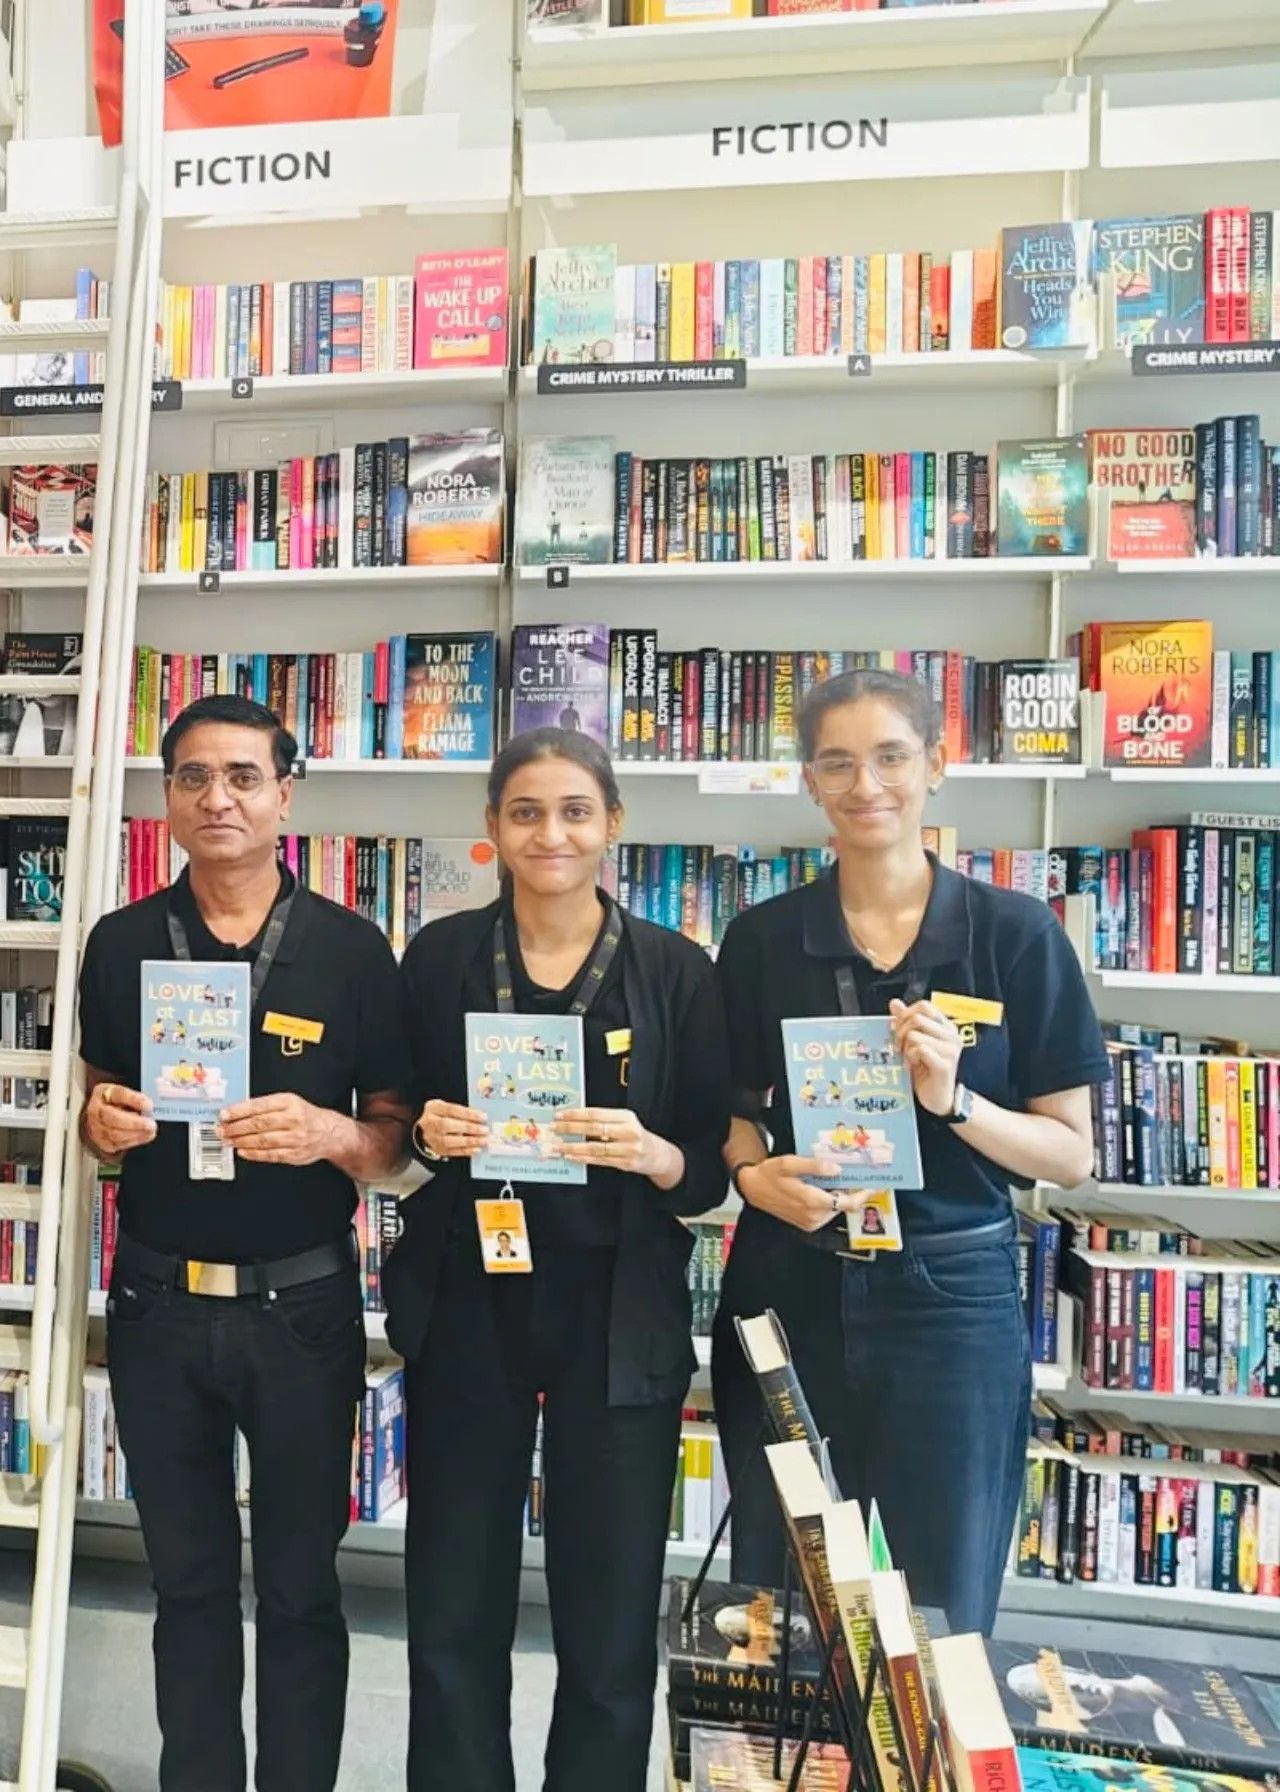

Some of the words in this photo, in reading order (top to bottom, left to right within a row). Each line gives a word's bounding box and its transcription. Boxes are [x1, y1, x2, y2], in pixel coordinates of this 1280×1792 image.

[712, 118, 889, 156] FICTION
[174, 150, 332, 188] FICTION
[1100, 222, 1202, 249] STEPHEN
[421, 258, 452, 272] BETH
[1006, 250, 1076, 275] Arche
[1108, 245, 1194, 274] KING
[452, 276, 474, 288] THE
[546, 274, 613, 295] Archer
[1023, 279, 1072, 295] Heads
[1031, 291, 1063, 306] You
[437, 308, 484, 328] CALL
[1029, 304, 1064, 321] Win
[1145, 352, 1198, 367] CRIME
[1200, 350, 1272, 366] MYSTERY
[549, 371, 596, 386] CRIME
[597, 369, 665, 385] MYSTERY
[666, 367, 734, 382] THRILLER
[14, 393, 73, 408] GENERAL
[74, 391, 104, 406] AND
[1096, 434, 1126, 458] NO
[1136, 433, 1194, 457] GOOD
[426, 473, 476, 490] NORA
[1097, 460, 1196, 487] BROTHER
[412, 486, 491, 506] ROBERTS
[418, 508, 484, 523] HIDEAWAY
[529, 633, 594, 646] REACHER
[1130, 639, 1183, 657] NORA
[424, 644, 442, 663] TO
[449, 643, 475, 662] THE
[538, 648, 585, 664] LEE
[428, 664, 470, 682] MOON
[625, 636, 637, 697] UPGRADE
[642, 636, 655, 697] UPGRADE
[1111, 656, 1200, 675] ROBERTS
[519, 666, 603, 685] CHILD
[1232, 669, 1250, 700] LIES
[414, 686, 443, 705] AND
[444, 685, 483, 705] BACK
[1006, 674, 1077, 700] ROBIN
[773, 664, 792, 732] PASSAGE
[423, 713, 472, 732] ELIANA
[1005, 699, 1078, 729] COOK
[1117, 715, 1193, 734] BLOOD
[418, 733, 476, 751] RAMAGE
[1013, 733, 1069, 754] COMA
[1123, 740, 1184, 759] BONE
[1206, 813, 1255, 827] GUEST
[1257, 815, 1280, 828] LIS
[444, 871, 471, 882] OLD
[425, 882, 470, 894] TOKYO
[147, 983, 205, 1001] LOVE
[188, 1009, 242, 1027] LAST
[473, 1035, 534, 1054] LOVE
[792, 1040, 858, 1062] LOVE
[517, 1061, 575, 1081] LAST
[840, 1065, 902, 1085] LAST
[693, 1667, 720, 1685] THE
[1041, 1735, 1154, 1763] MAIDENS
